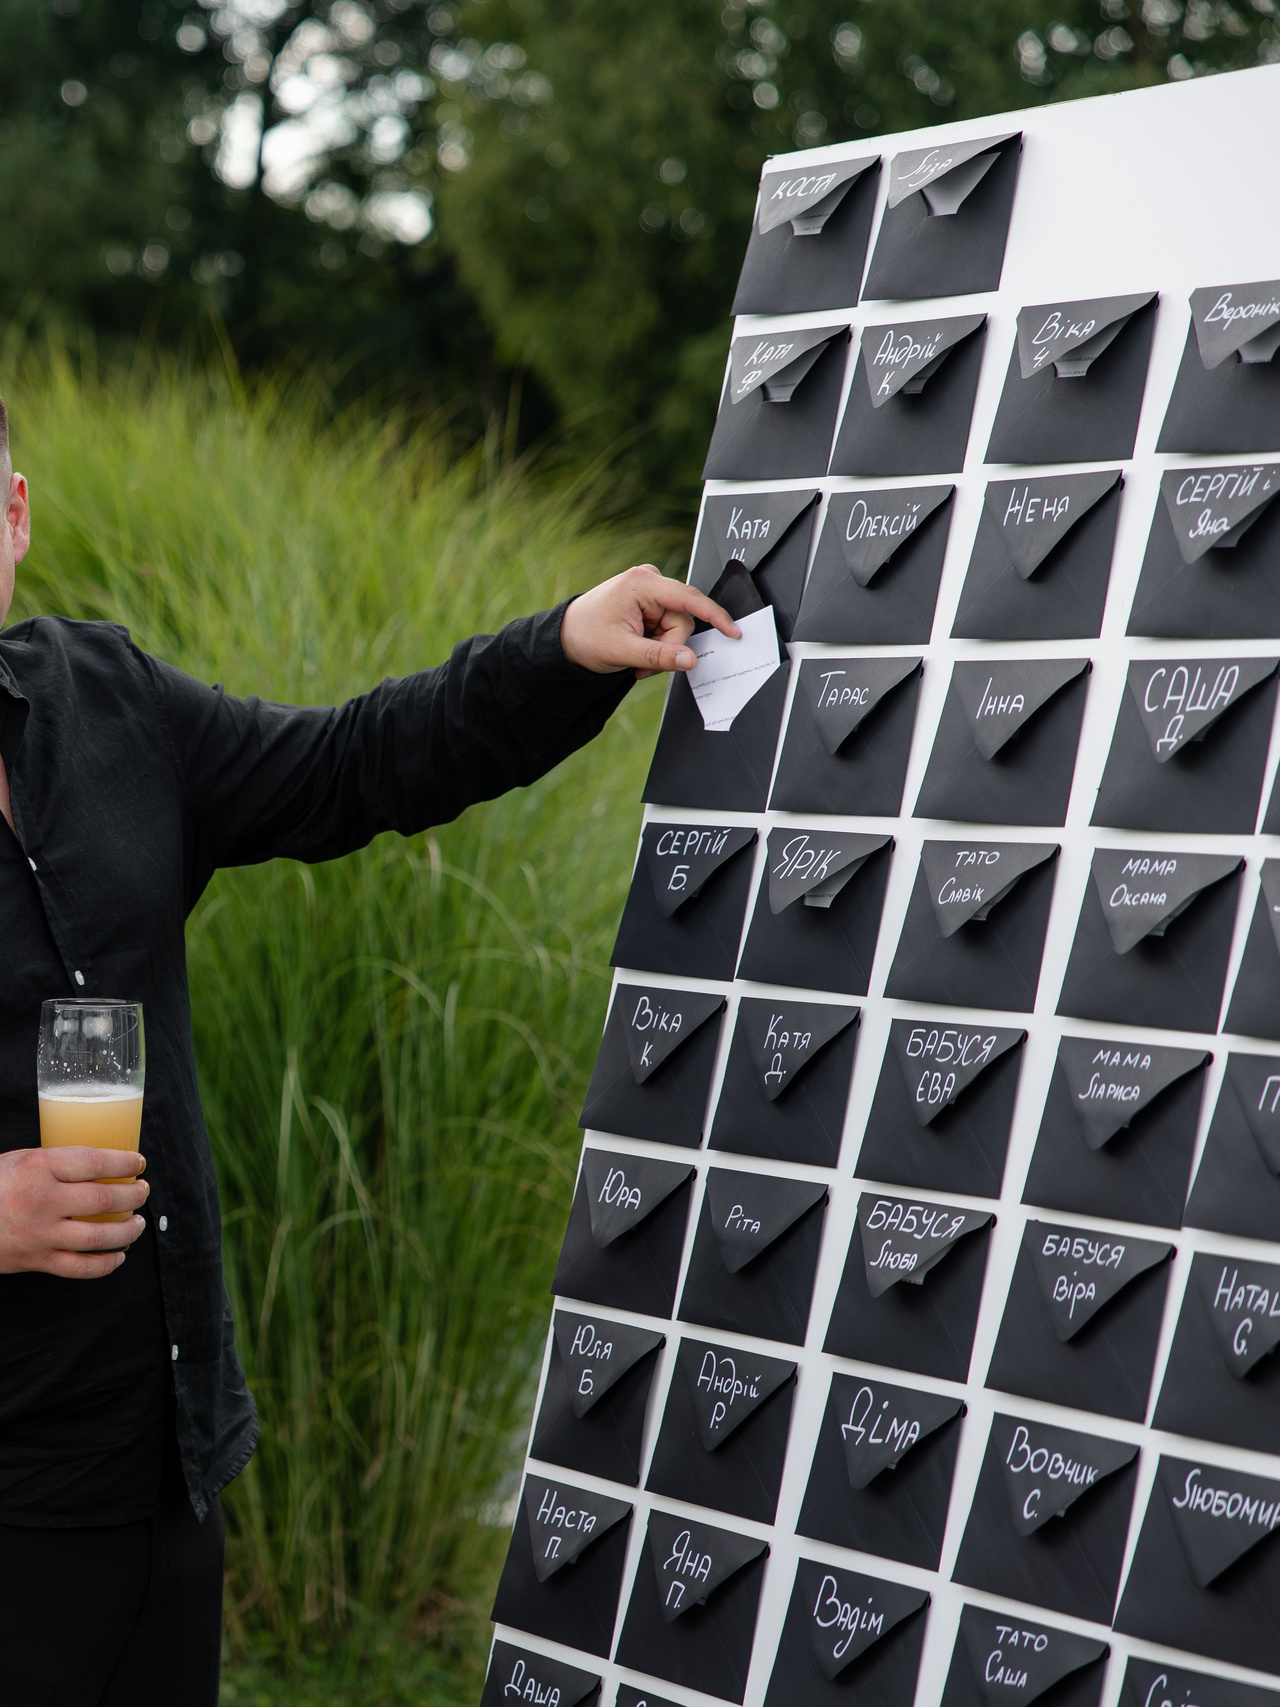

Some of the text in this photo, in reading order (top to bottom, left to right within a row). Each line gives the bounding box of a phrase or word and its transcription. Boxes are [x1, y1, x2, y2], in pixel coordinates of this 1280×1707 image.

[1174, 465, 1263, 505] СЕРГІЙ
[1189, 508, 1230, 538] Яна
[656, 828, 731, 856] СЕРГІЙ
[667, 865, 690, 890] Б.
[640, 1041, 653, 1067] К.
[578, 1369, 593, 1395] Б.
[710, 1401, 726, 1429] Р.
[1023, 1488, 1041, 1519] С.
[544, 1536, 561, 1559] П.
[665, 1581, 686, 1608] П.
